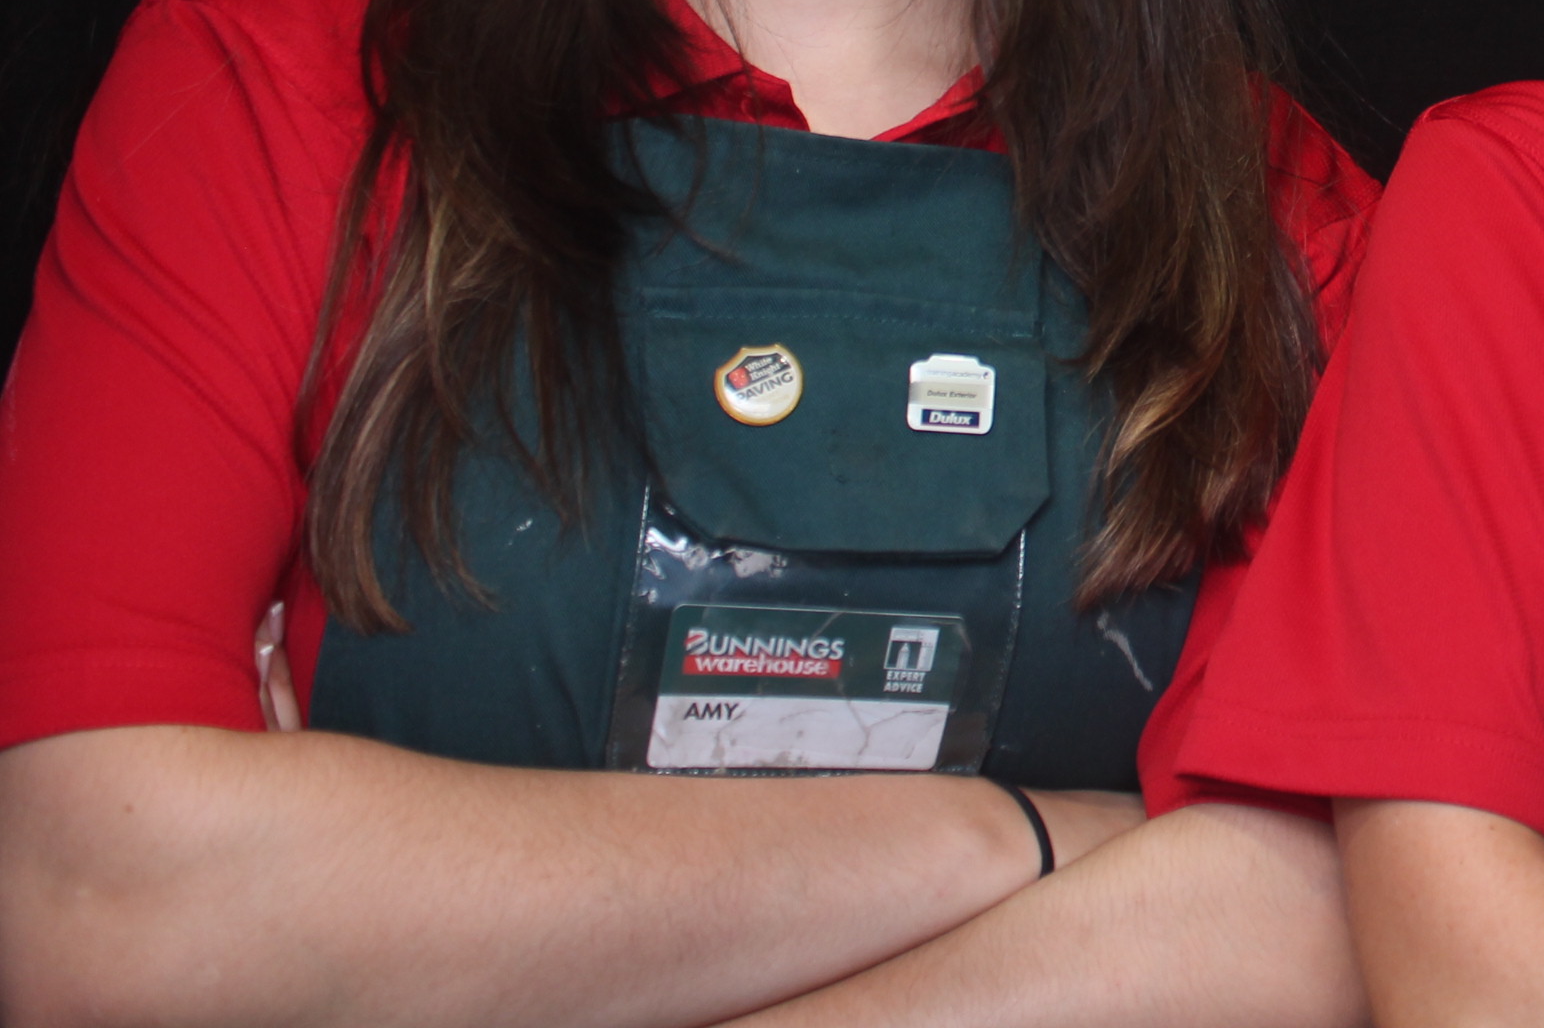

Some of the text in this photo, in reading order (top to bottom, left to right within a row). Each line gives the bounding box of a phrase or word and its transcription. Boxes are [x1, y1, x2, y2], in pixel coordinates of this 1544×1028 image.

[745, 358, 773, 371] White
[750, 363, 781, 381] Knight
[929, 411, 972, 425] Dulux
[685, 629, 845, 660] BUNNINGS
[695, 656, 829, 676] warehouse
[886, 671, 926, 682] EXPERT
[883, 682, 923, 693] ADVICE
[684, 703, 739, 720] AMY
